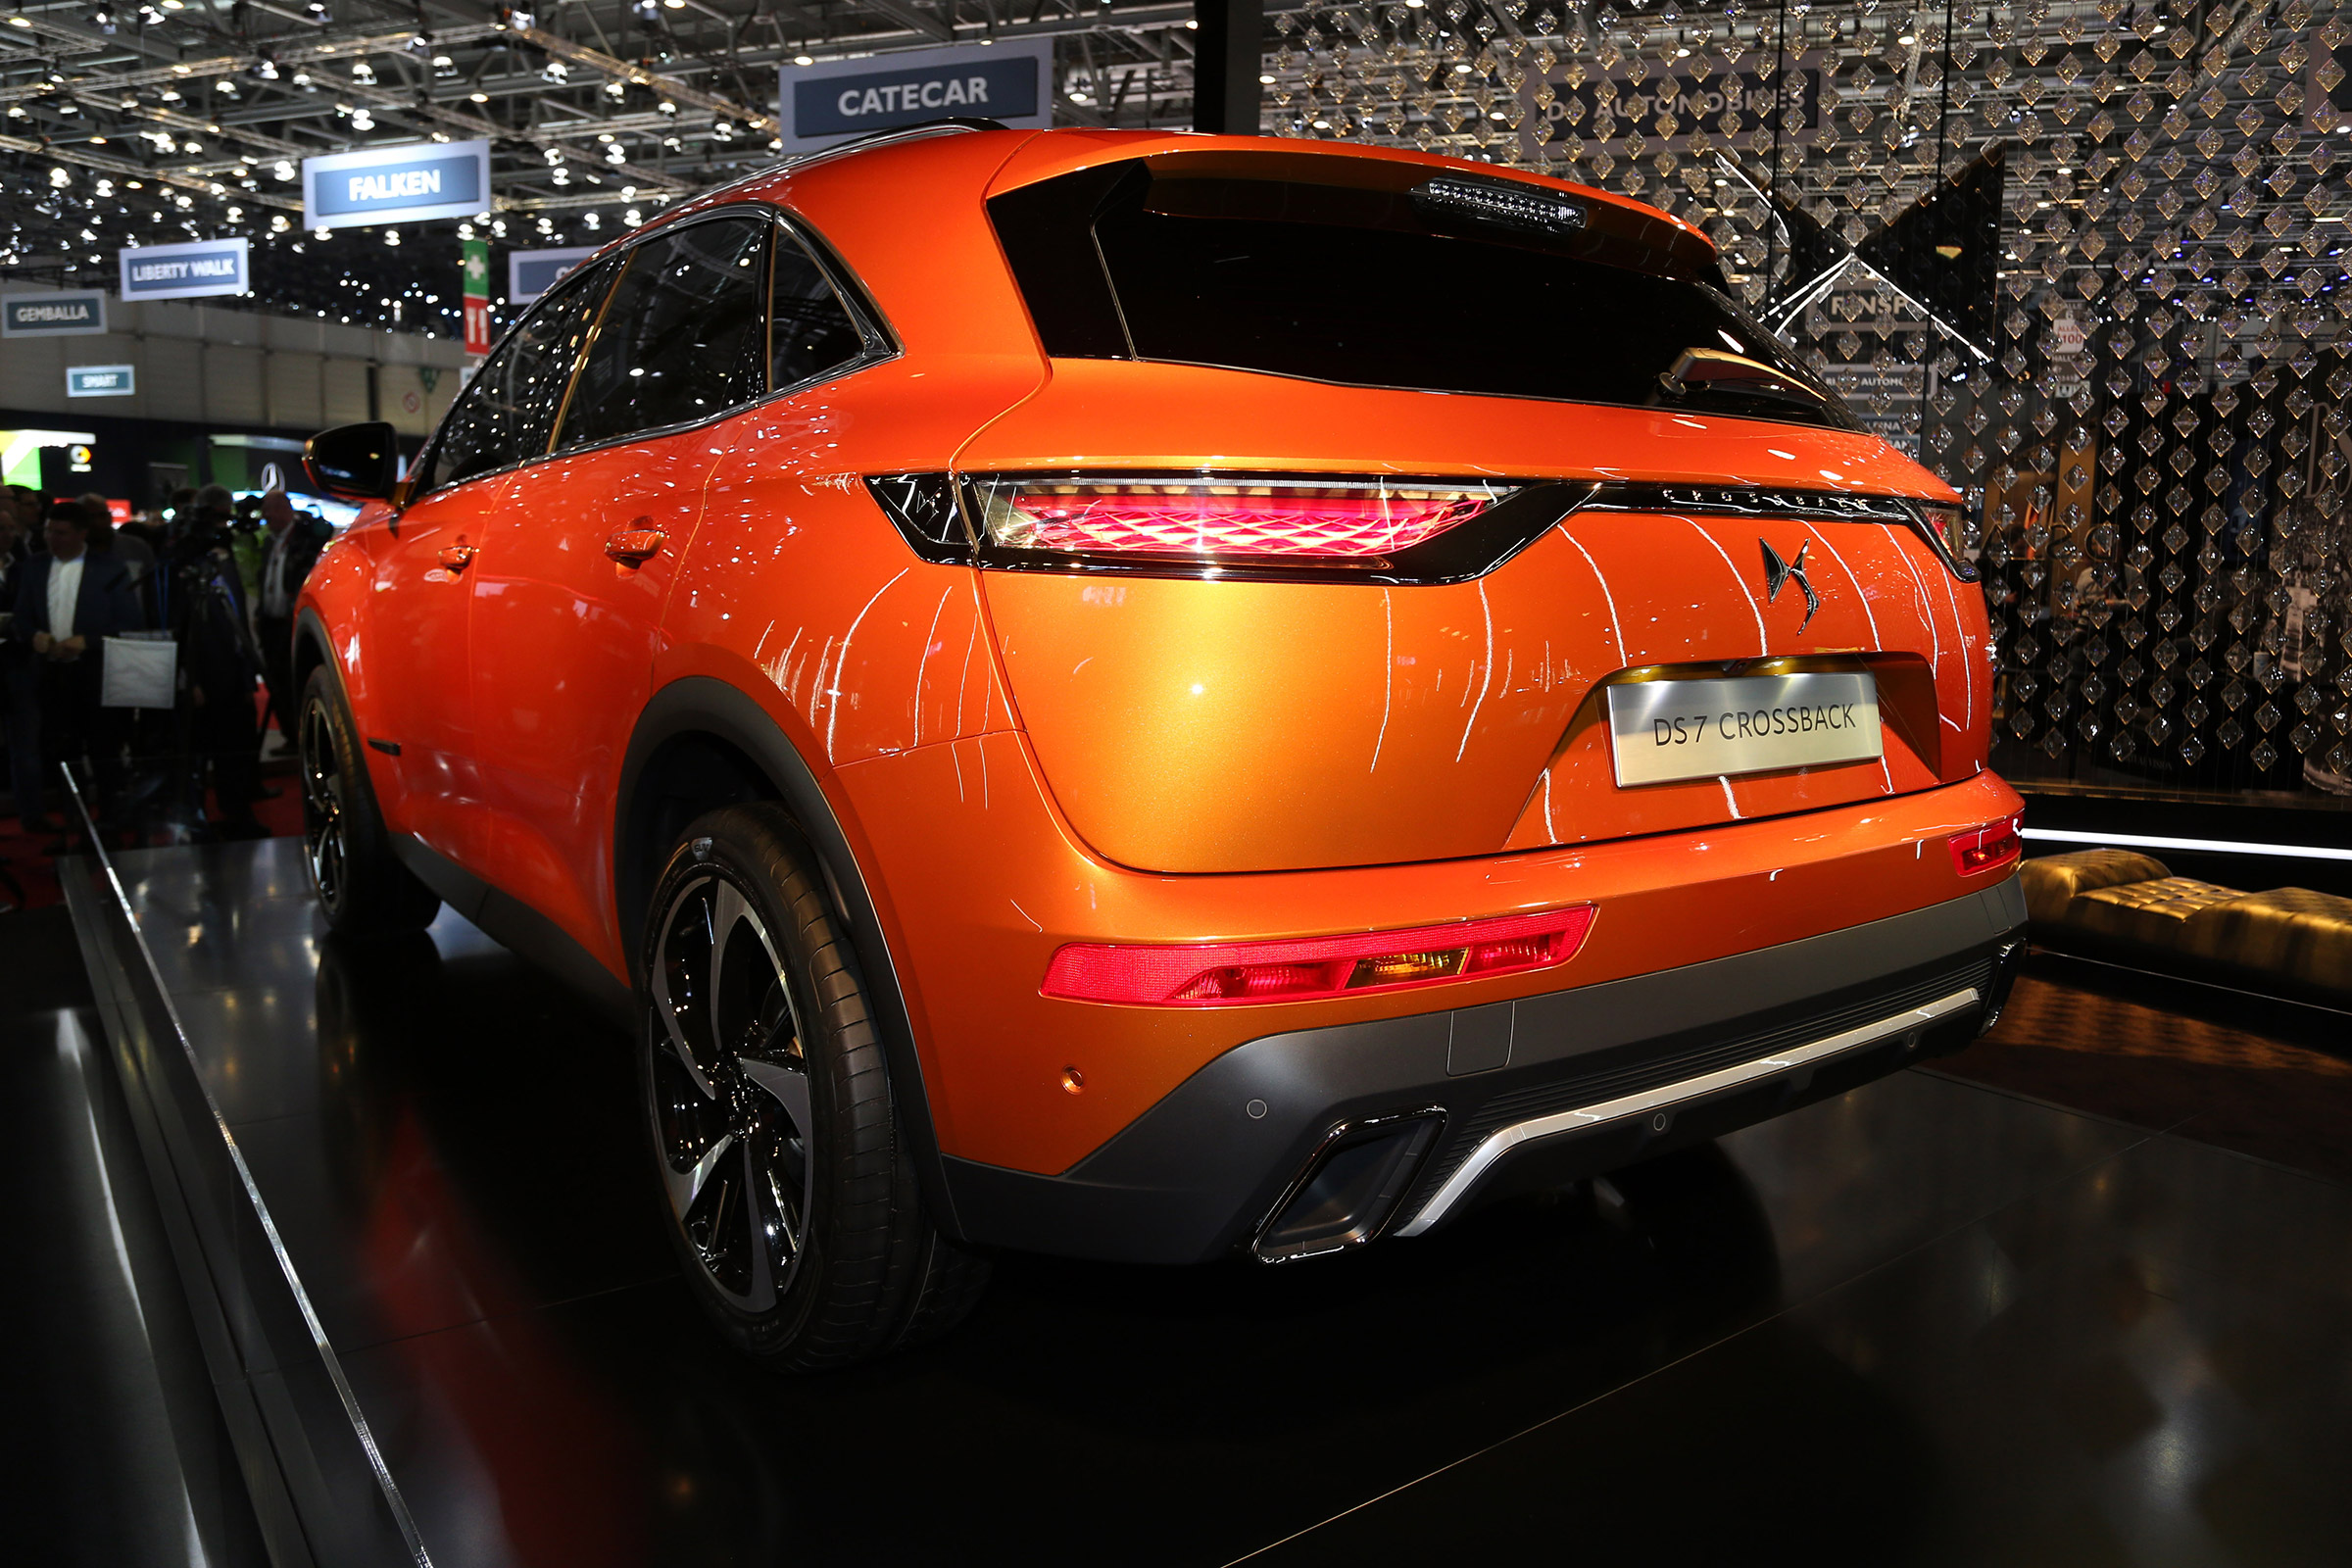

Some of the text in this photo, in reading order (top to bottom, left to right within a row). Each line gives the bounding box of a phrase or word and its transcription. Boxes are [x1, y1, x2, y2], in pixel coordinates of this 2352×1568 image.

[838, 76, 989, 117] CATECAR
[349, 169, 440, 202] FALKEN
[132, 258, 235, 281] LIBERTY WALK
[16, 305, 89, 322] GEMBALLA
[81, 373, 119, 388] SMART
[1719, 703, 1856, 740] CROSSBACK
